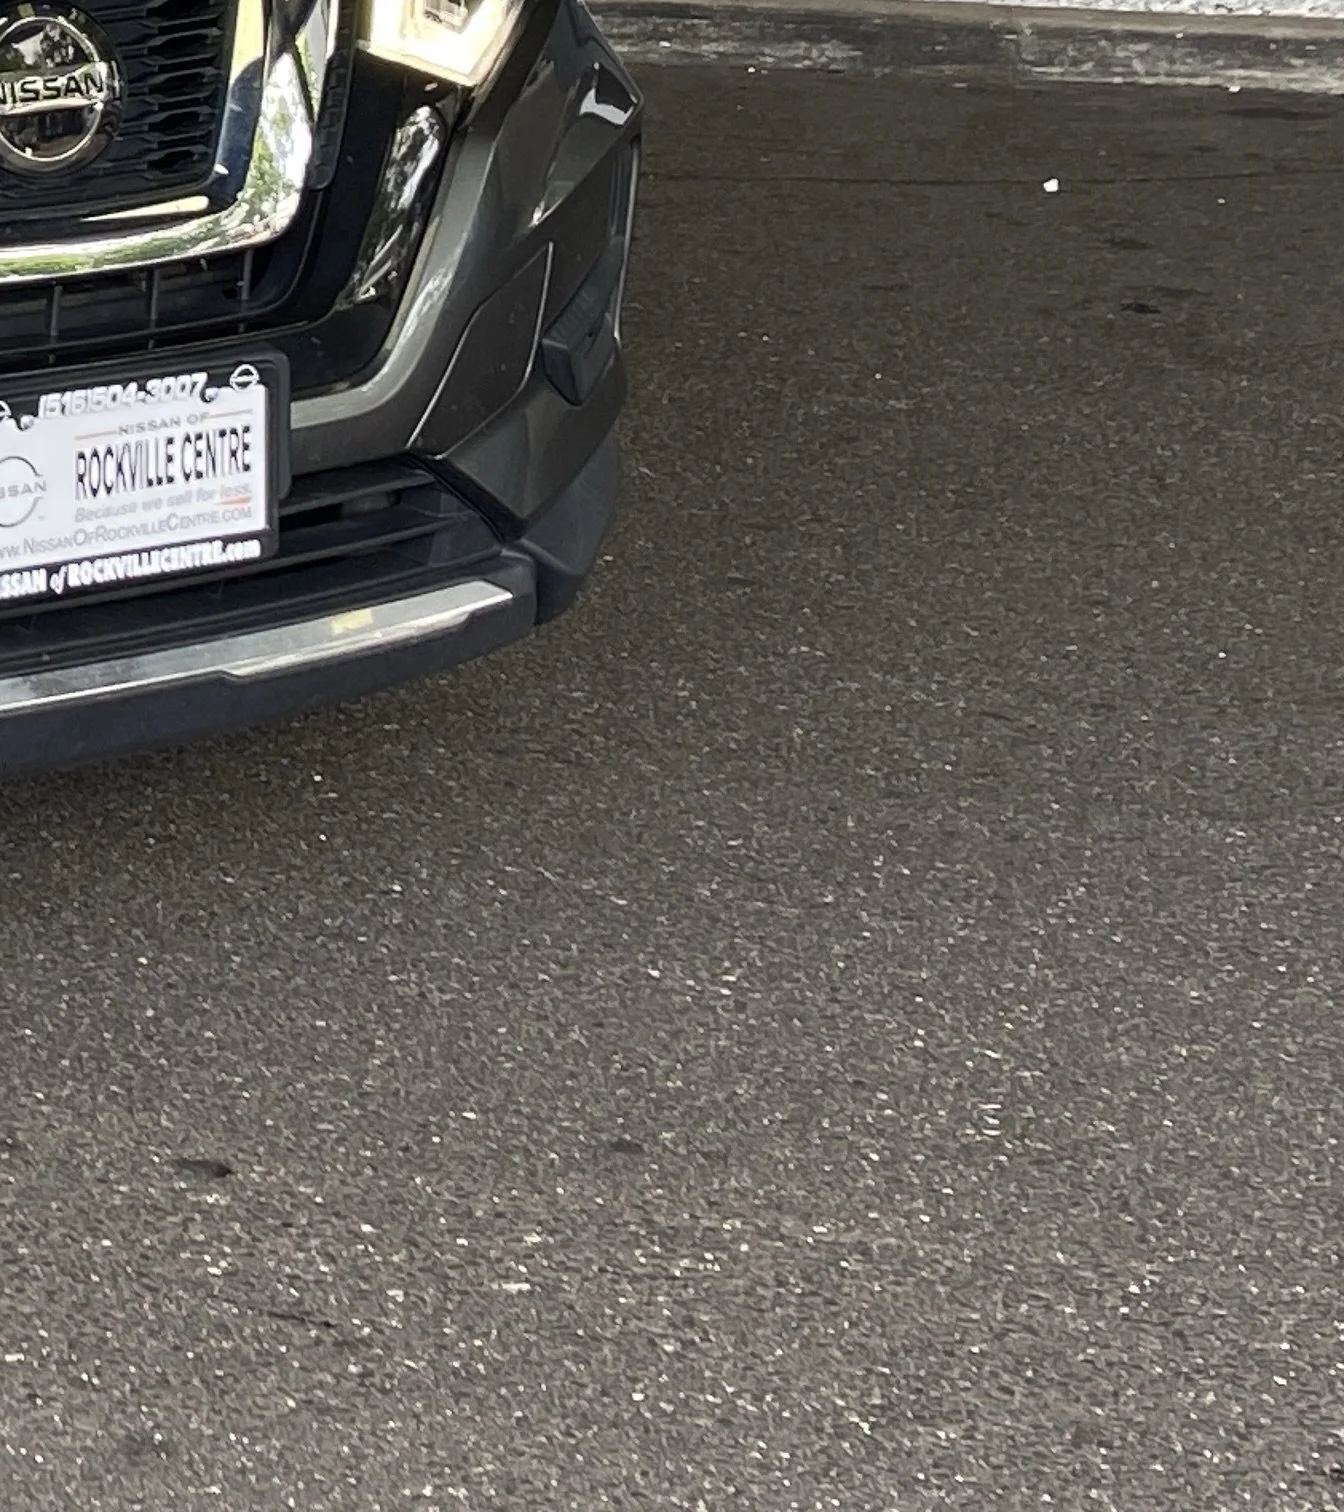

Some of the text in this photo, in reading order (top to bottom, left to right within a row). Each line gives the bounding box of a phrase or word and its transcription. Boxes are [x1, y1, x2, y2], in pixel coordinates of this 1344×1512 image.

[117, 416, 181, 436] NISSAN
[74, 425, 252, 500] ROCKVILLE CENTRE
[49, 564, 68, 595] of
